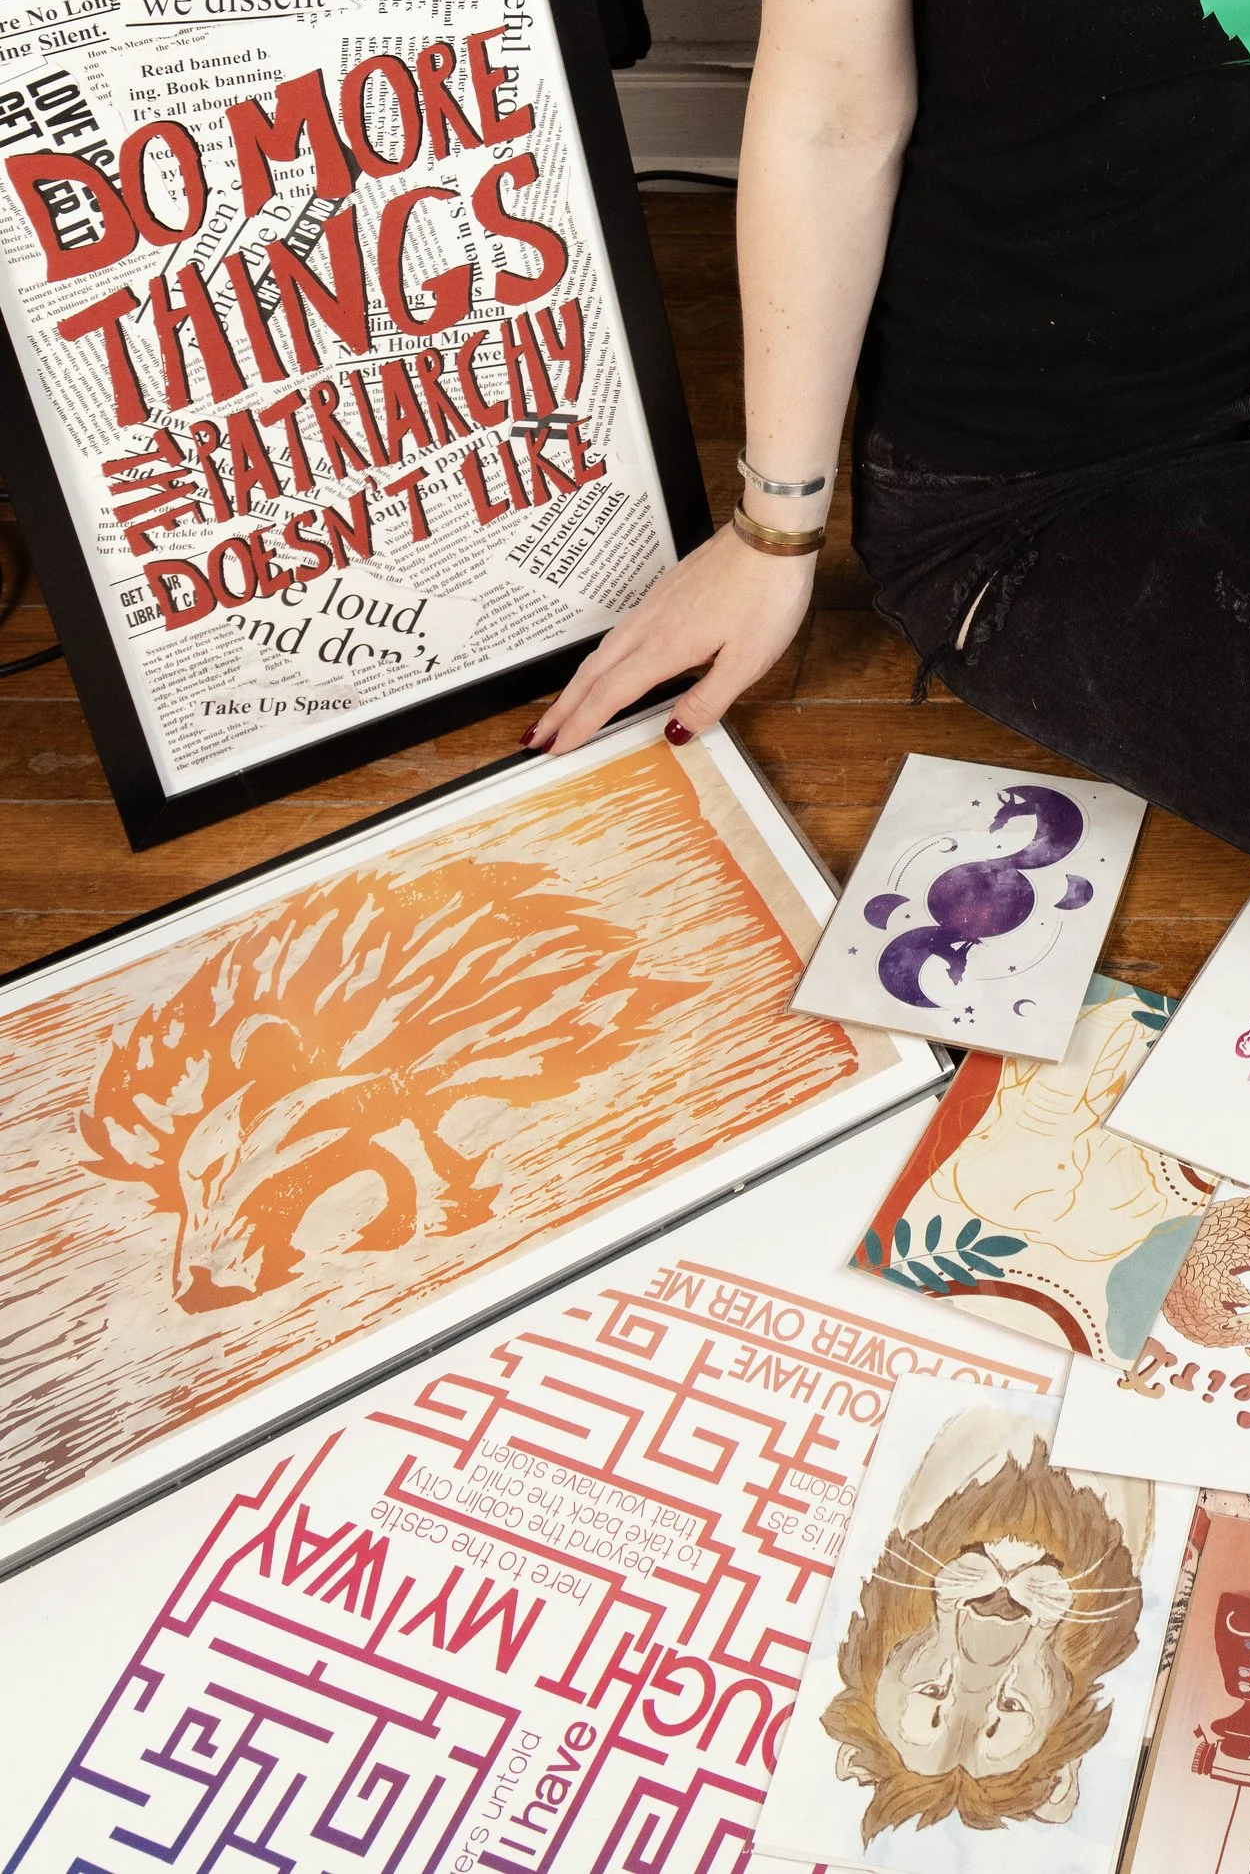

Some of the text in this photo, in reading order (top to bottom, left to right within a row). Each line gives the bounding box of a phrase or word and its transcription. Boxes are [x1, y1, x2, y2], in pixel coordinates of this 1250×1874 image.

[26, 5, 58, 27] No
[38, 24, 108, 52] Silent.
[129, 87, 161, 102] ing.
[167, 77, 209, 96] Book
[140, 51, 245, 78] Read banned
[26, 69, 100, 147] LOVE
[166, 101, 187, 117] all
[5, 24, 536, 283] DO MORE
[57, 152, 569, 427] THINGS
[389, 336, 433, 352] Hold
[101, 426, 202, 559] THE
[189, 297, 587, 524] PATRIARCHY
[143, 415, 607, 632] DOESN'T LIKE
[505, 536, 536, 564] The
[541, 481, 608, 558] Protecting
[546, 490, 625, 585] Public Lands
[120, 587, 145, 607] GET
[318, 578, 428, 638] loud.
[201, 697, 352, 717] Take Up Space
[644, 1267, 806, 1342] OVER ME
[727, 1345, 823, 1404] HAVE
[408, 1466, 656, 1580] beyond the Goblin City
[471, 1465, 703, 1571] to take back the child
[481, 1438, 698, 1541] that you have stolen.
[227, 1496, 546, 1674] MY WAY
[370, 1499, 593, 1607] here to the castle
[482, 1729, 541, 1820] untold
[509, 1721, 597, 1835] have
